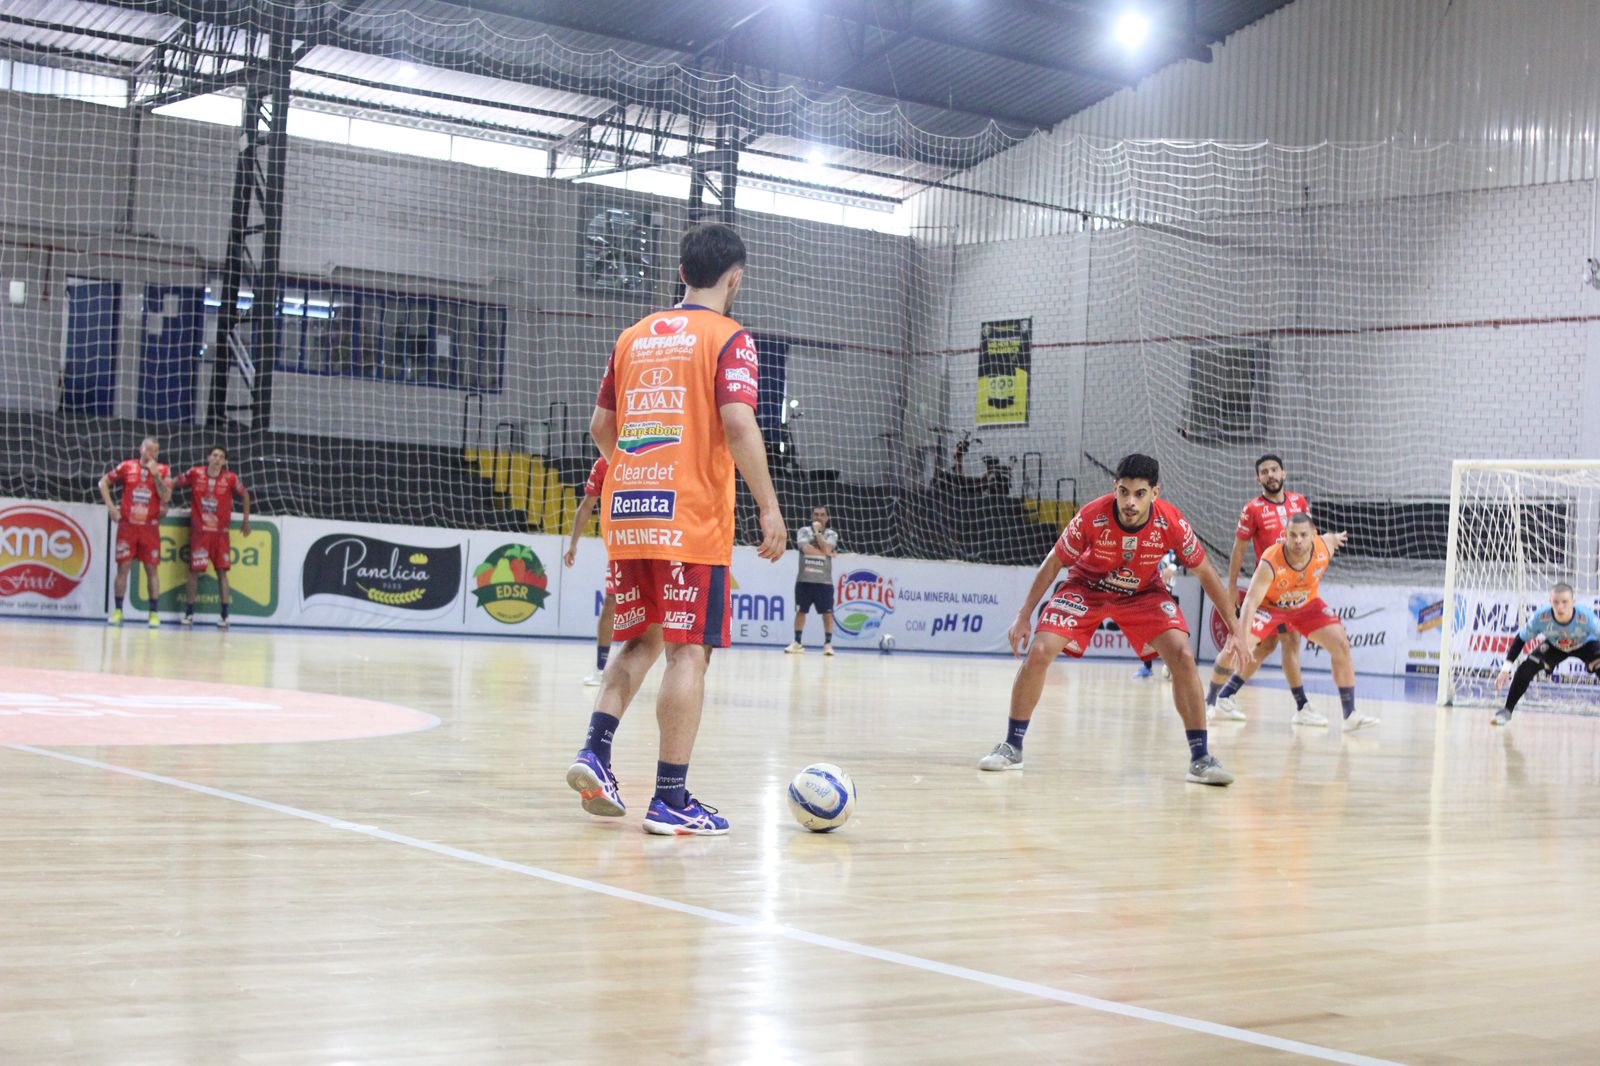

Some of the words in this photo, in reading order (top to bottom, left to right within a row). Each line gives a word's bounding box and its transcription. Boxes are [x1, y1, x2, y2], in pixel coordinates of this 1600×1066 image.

[613, 462, 675, 482] Cleardet
[612, 495, 670, 514] Renata
[615, 528, 683, 547] MEINERZ
[496, 585, 528, 598] EDSR
[836, 573, 895, 611] ferriê
[924, 591, 959, 604] MINERAL
[962, 592, 999, 605] NATURAL
[905, 619, 926, 632] COM
[931, 613, 958, 637] pH
[961, 614, 983, 633] 10
